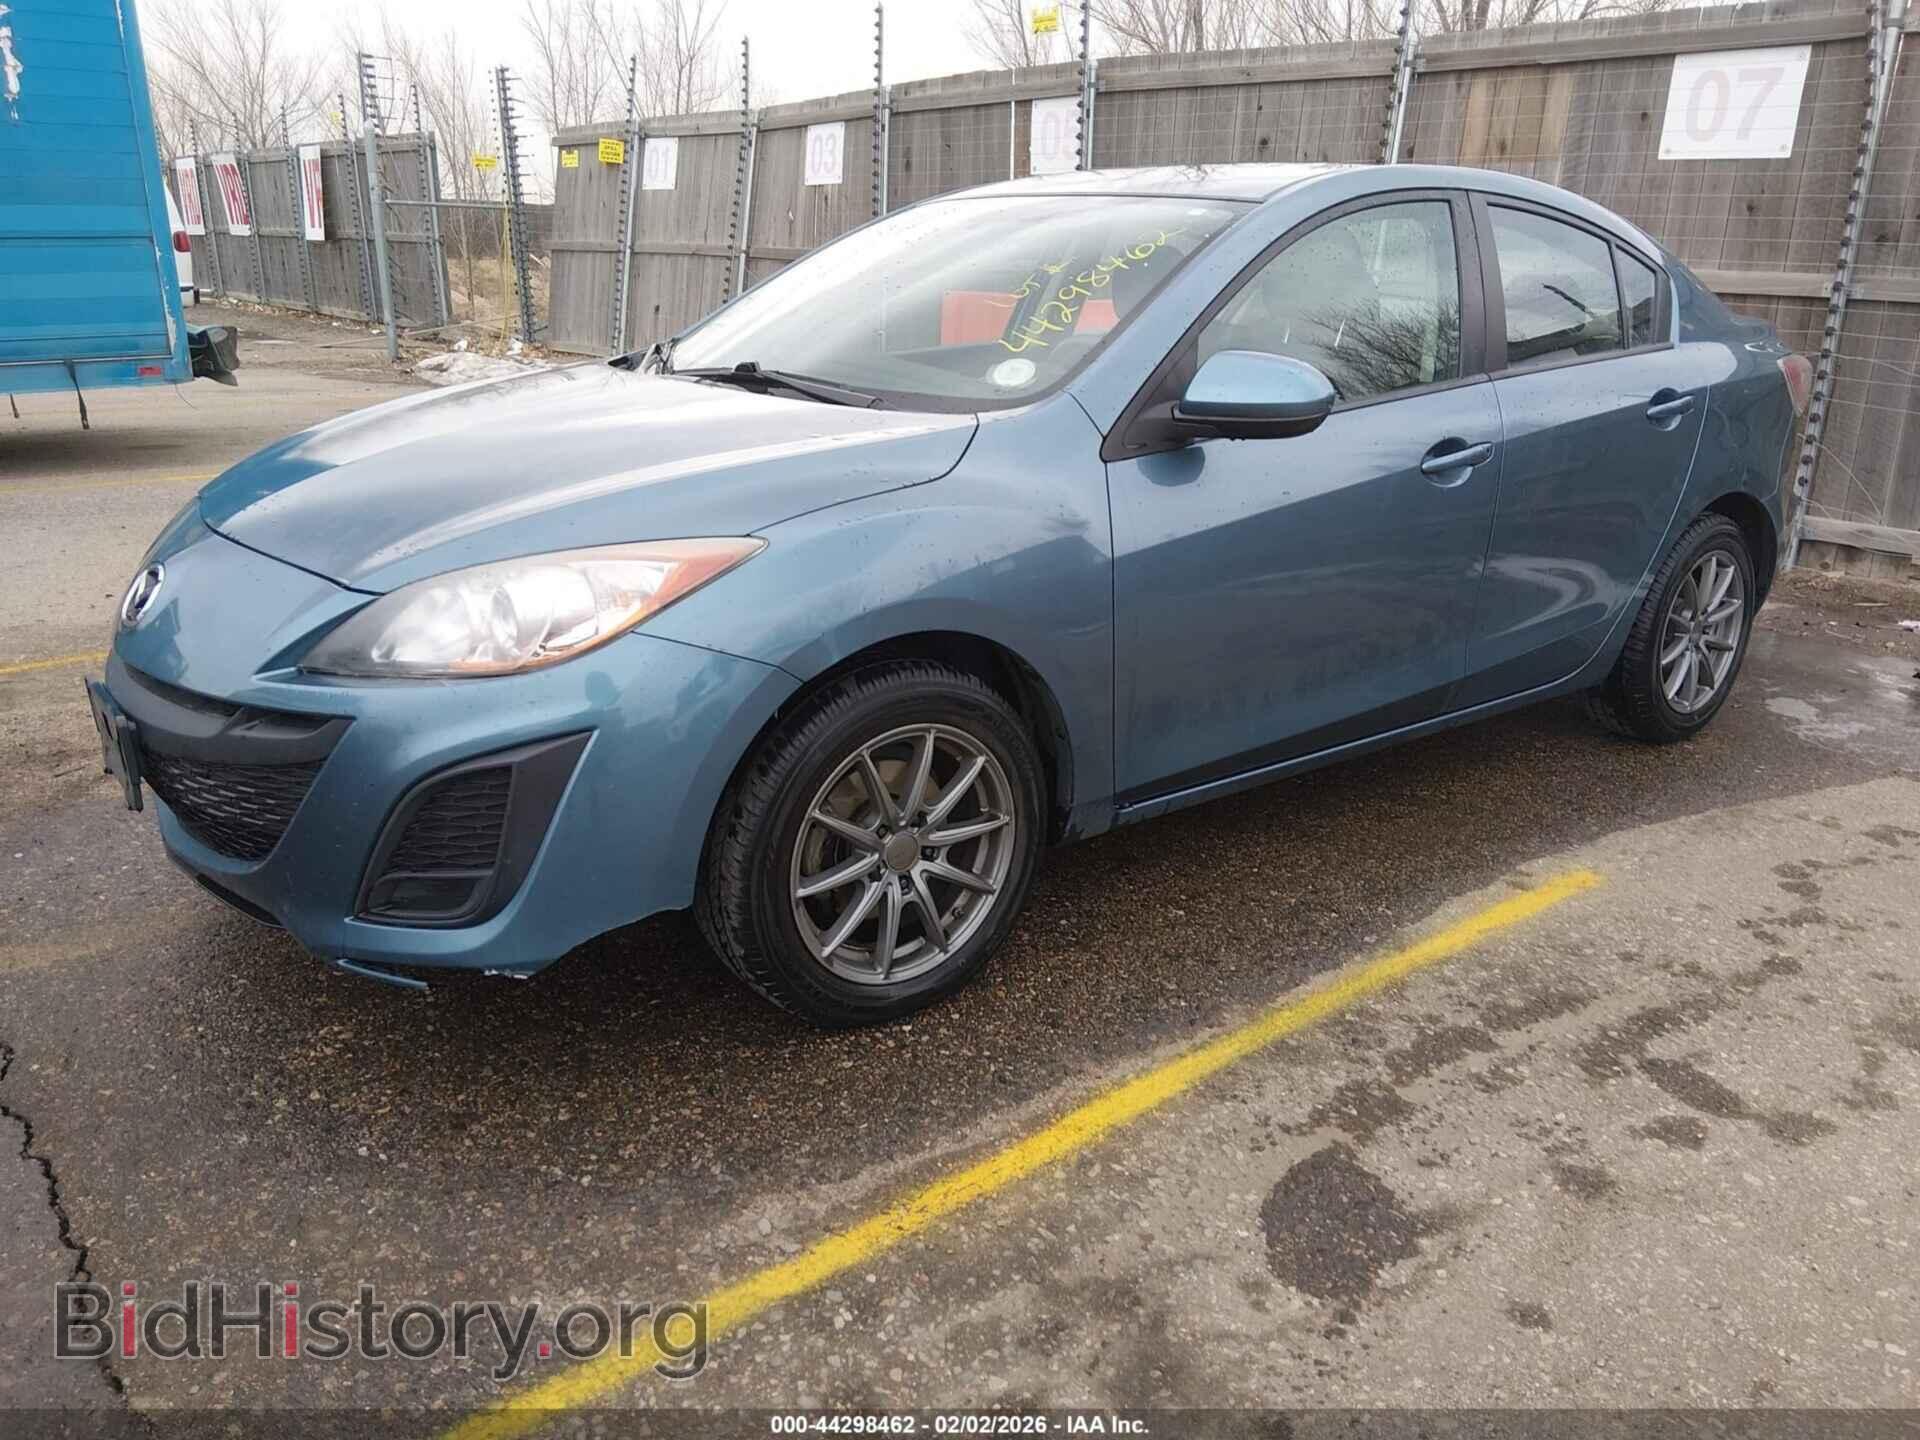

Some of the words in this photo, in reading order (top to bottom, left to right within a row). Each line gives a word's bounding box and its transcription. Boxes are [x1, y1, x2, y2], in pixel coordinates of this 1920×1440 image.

[1686, 66, 1785, 142] 07
[648, 145, 670, 182] 01
[811, 133, 837, 176] 03
[998, 228, 1188, 353] 44298462
